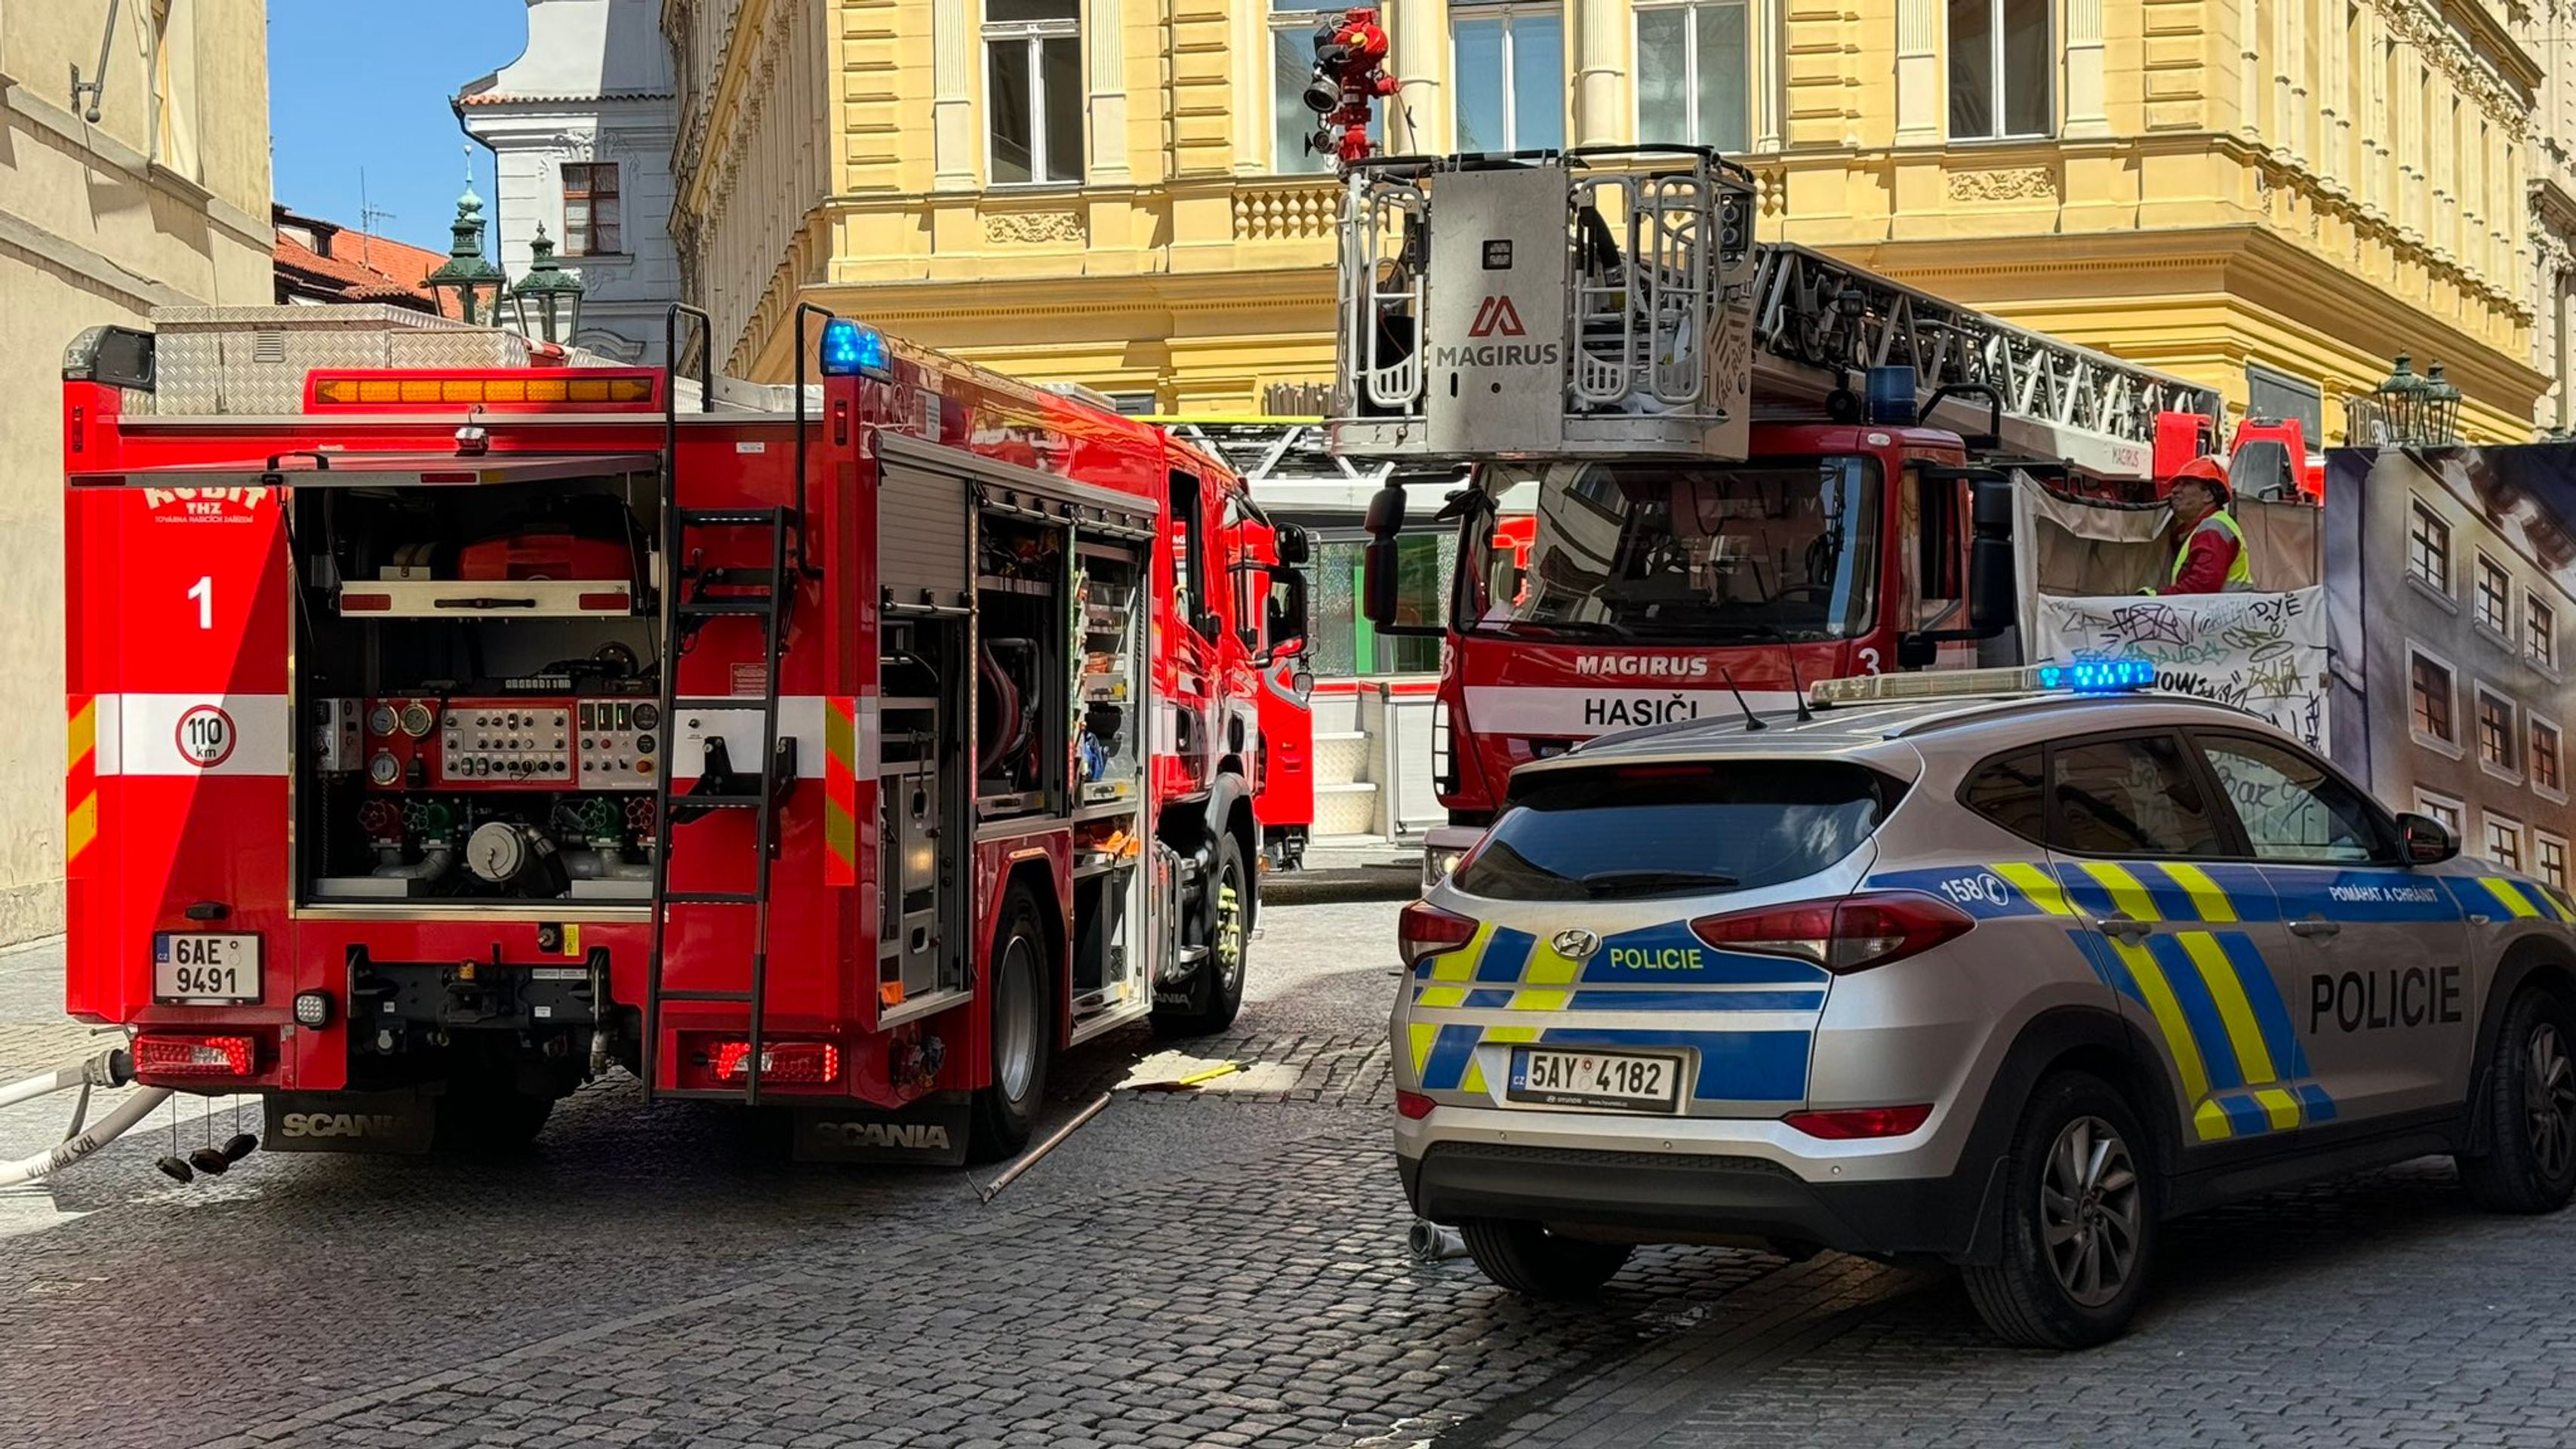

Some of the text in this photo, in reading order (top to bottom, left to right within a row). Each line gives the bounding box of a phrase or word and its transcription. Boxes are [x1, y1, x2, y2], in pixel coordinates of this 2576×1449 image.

[1436, 343, 1558, 368] MAGIRUS
[186, 502, 222, 515] THZ
[186, 576, 213, 629] 1
[1575, 655, 1709, 677] MAGIRUS
[1584, 693, 1697, 726] HASIČI
[188, 718, 223, 745] 110
[196, 745, 217, 758] km
[1939, 877, 1984, 903] 158
[2383, 887, 2395, 902] A
[157, 952, 168, 961] CZ
[175, 939, 222, 965] 6AE
[1610, 948, 1704, 970] POLICIE
[177, 968, 237, 994] 9491
[2310, 965, 2462, 1035] POLICIE
[1513, 1076, 1526, 1086] CZ
[1531, 1055, 1661, 1095] 5AY 4182
